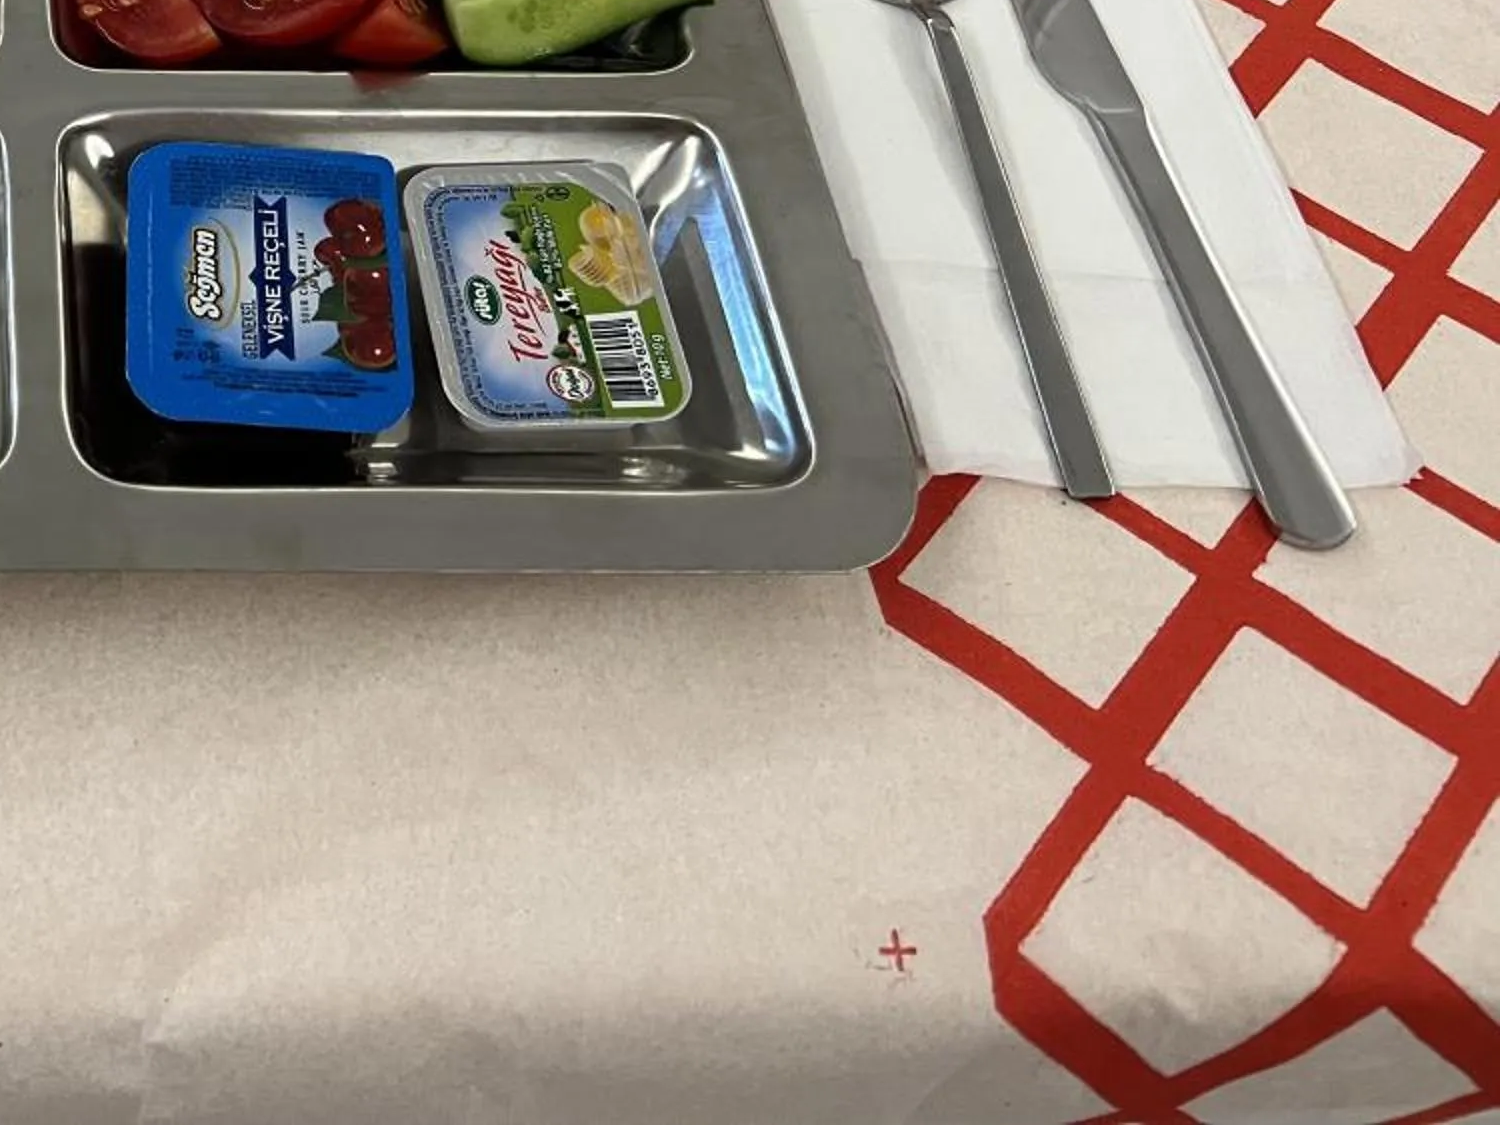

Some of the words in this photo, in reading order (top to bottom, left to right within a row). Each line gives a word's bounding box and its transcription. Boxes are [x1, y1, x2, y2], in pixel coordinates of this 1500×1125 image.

[257, 209, 284, 281] REÇELİ
[261, 285, 289, 345] VİŞNE
[484, 238, 549, 363] Tereyağı
